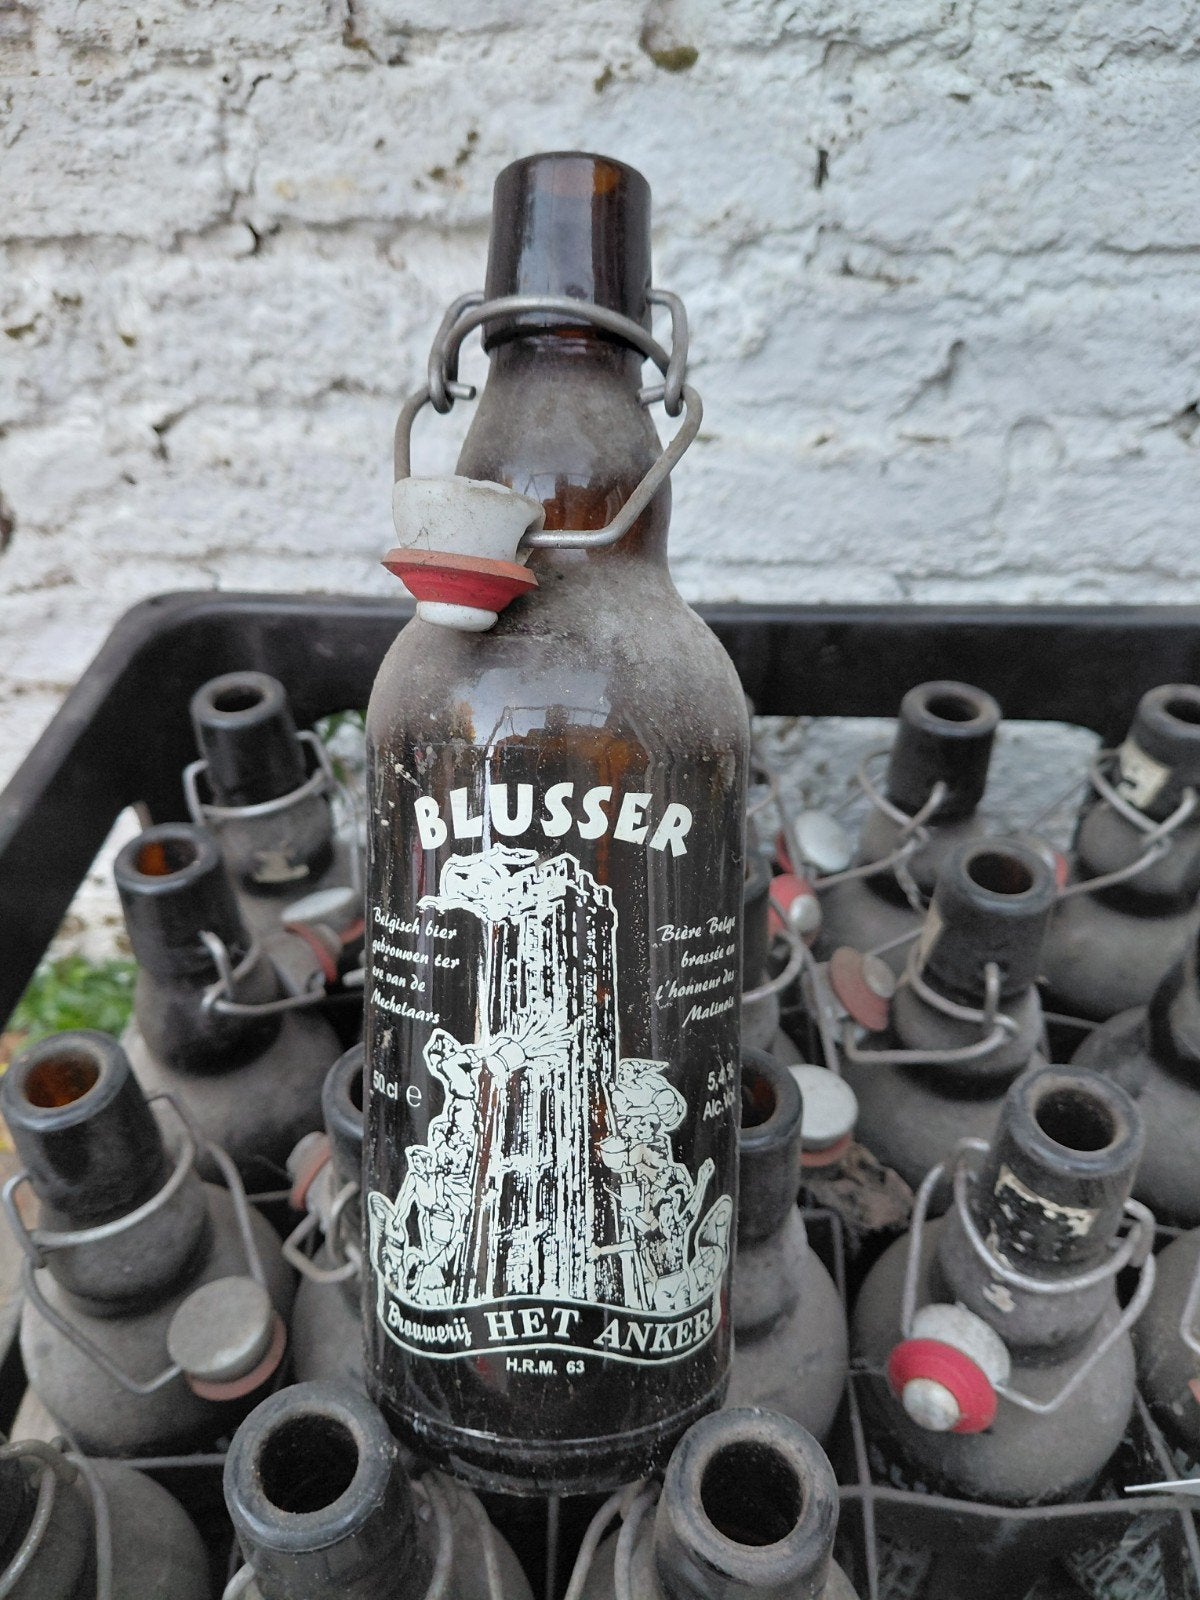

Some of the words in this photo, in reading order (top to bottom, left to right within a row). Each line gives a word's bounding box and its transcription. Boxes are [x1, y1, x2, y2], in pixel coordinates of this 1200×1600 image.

[414, 782, 693, 858] BLUSSER
[373, 906, 420, 935] Belgisch
[425, 920, 458, 939] bier
[656, 924, 702, 941] Bière
[372, 937, 429, 965] gebrouwen
[434, 953, 460, 969] ter
[681, 945, 725, 968] brassée
[386, 973, 407, 988] van
[410, 973, 426, 992] de
[722, 968, 735, 985] des
[370, 987, 440, 1024] Mechelaars
[387, 1300, 472, 1347] Brouwerij
[483, 1307, 580, 1341] HET
[593, 1308, 713, 1352] ANKER
[506, 1356, 558, 1376] H.R.M.
[565, 1359, 585, 1374] 63
